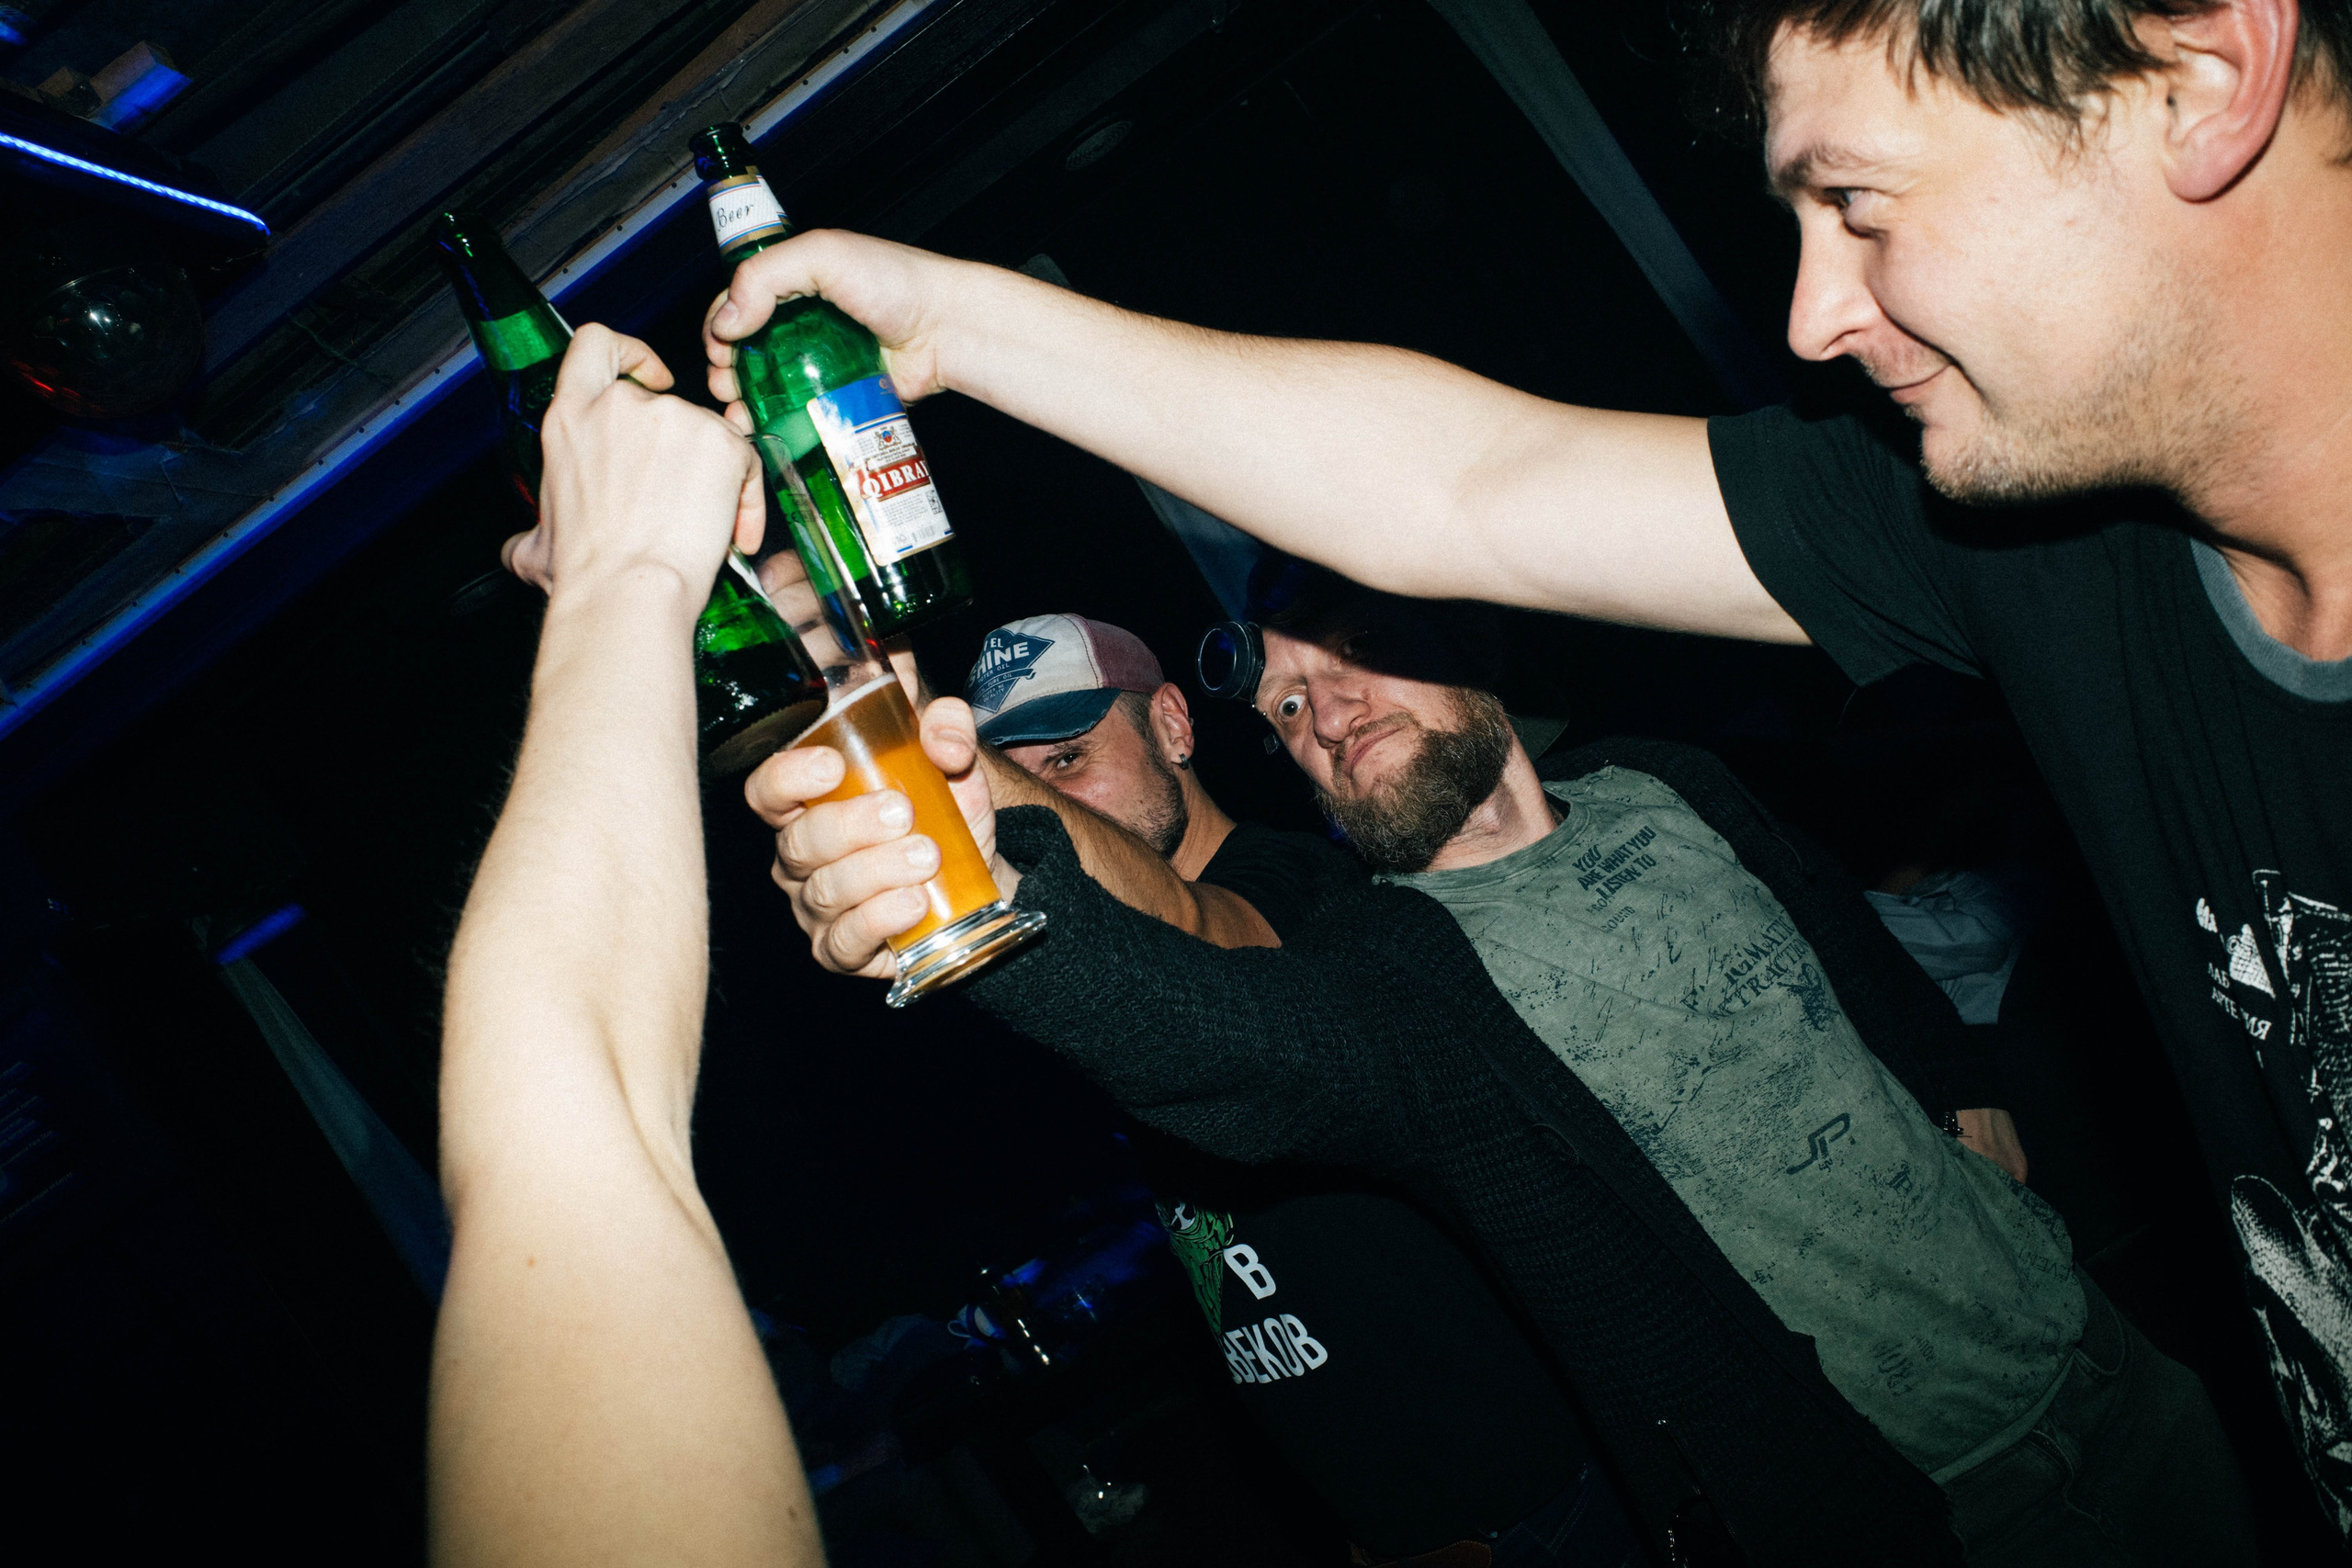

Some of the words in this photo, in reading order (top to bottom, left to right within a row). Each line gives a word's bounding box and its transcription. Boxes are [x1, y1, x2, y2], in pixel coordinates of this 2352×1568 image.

[716, 203, 755, 231] Beer
[983, 637, 1004, 652] EL
[967, 640, 1030, 689] SHINE
[996, 662, 1011, 671] OIL
[1571, 843, 1602, 873] YOU
[1577, 868, 1607, 892] ARE
[1597, 843, 1634, 874] WHAT
[1625, 825, 1657, 852] YOU
[1633, 853, 1657, 871] TO
